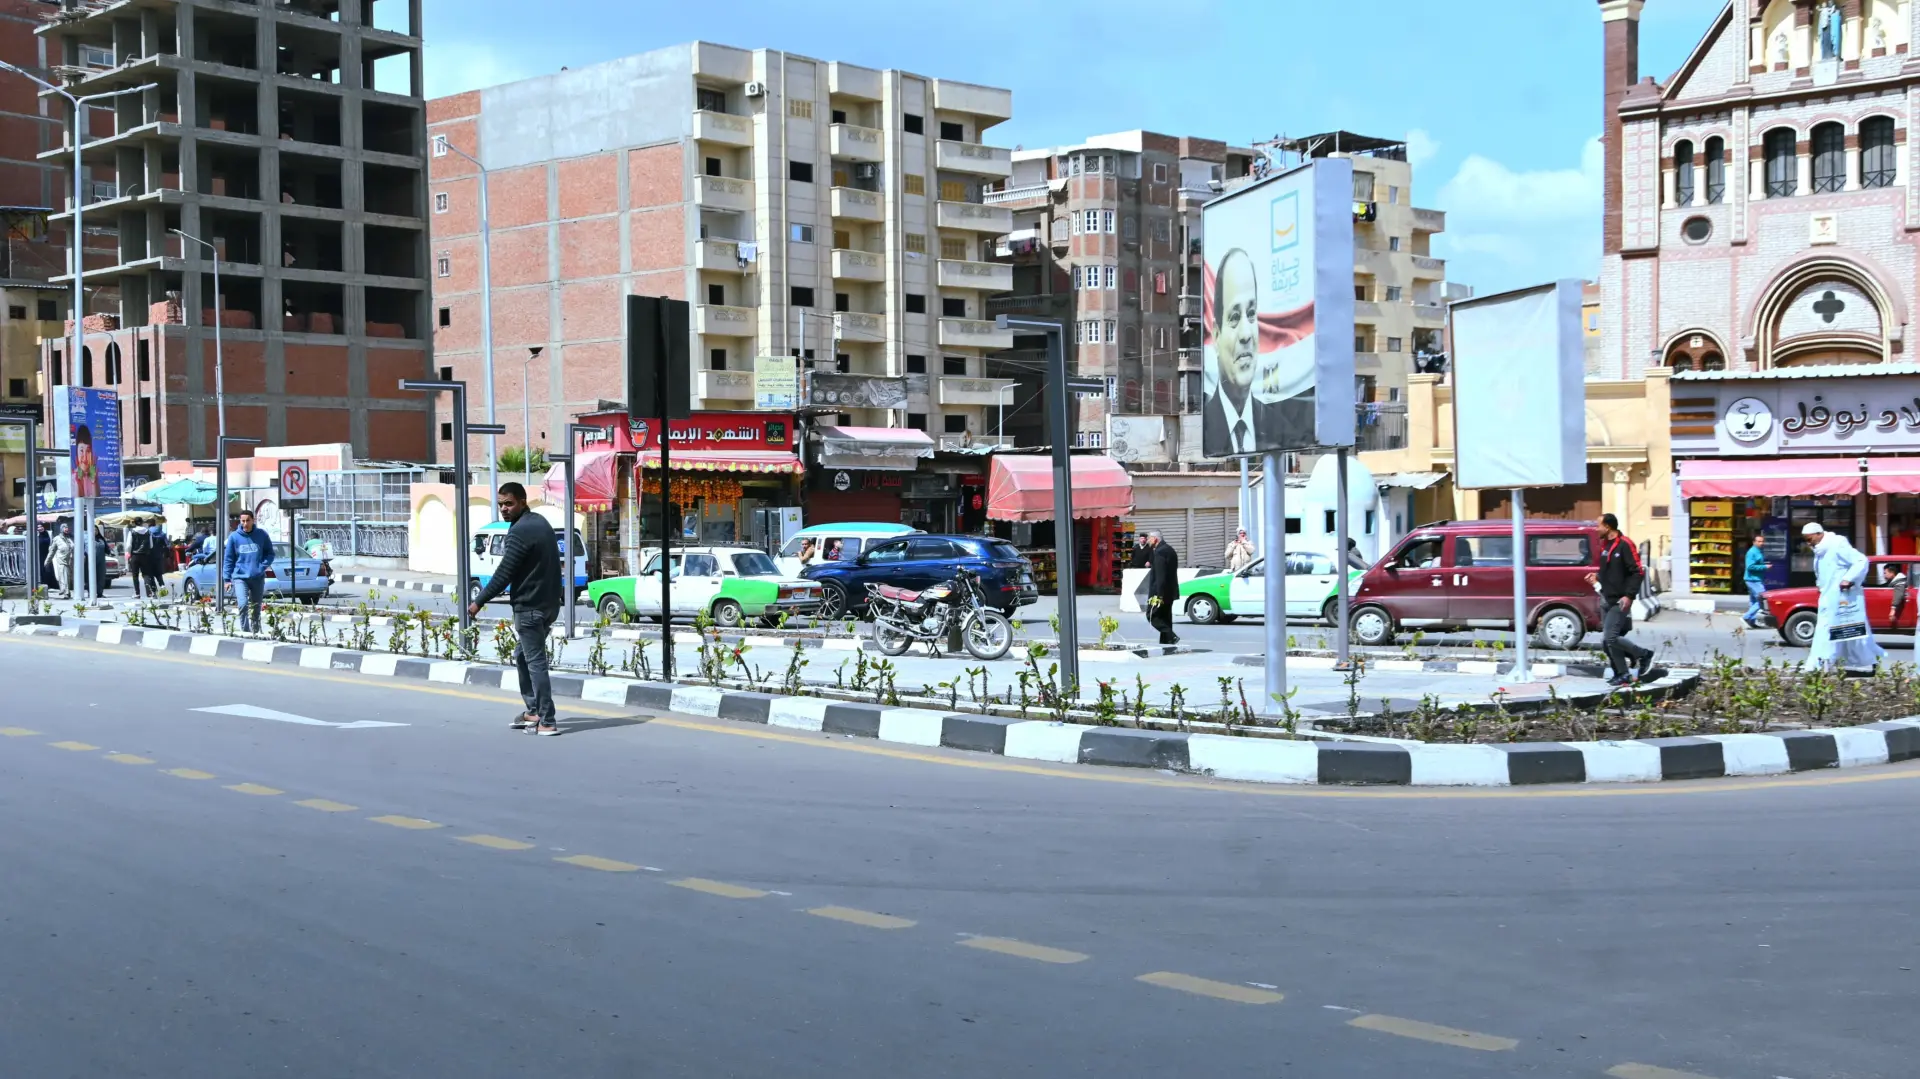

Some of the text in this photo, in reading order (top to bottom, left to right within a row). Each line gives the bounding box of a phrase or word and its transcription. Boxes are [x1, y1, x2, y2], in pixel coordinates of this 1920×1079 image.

[1271, 257, 1299, 276] حياة
[1271, 271, 1299, 292] كريمة
[1783, 395, 1868, 435] نوفل
[706, 426, 759, 442] الشهد
[291, 470, 300, 489] P
